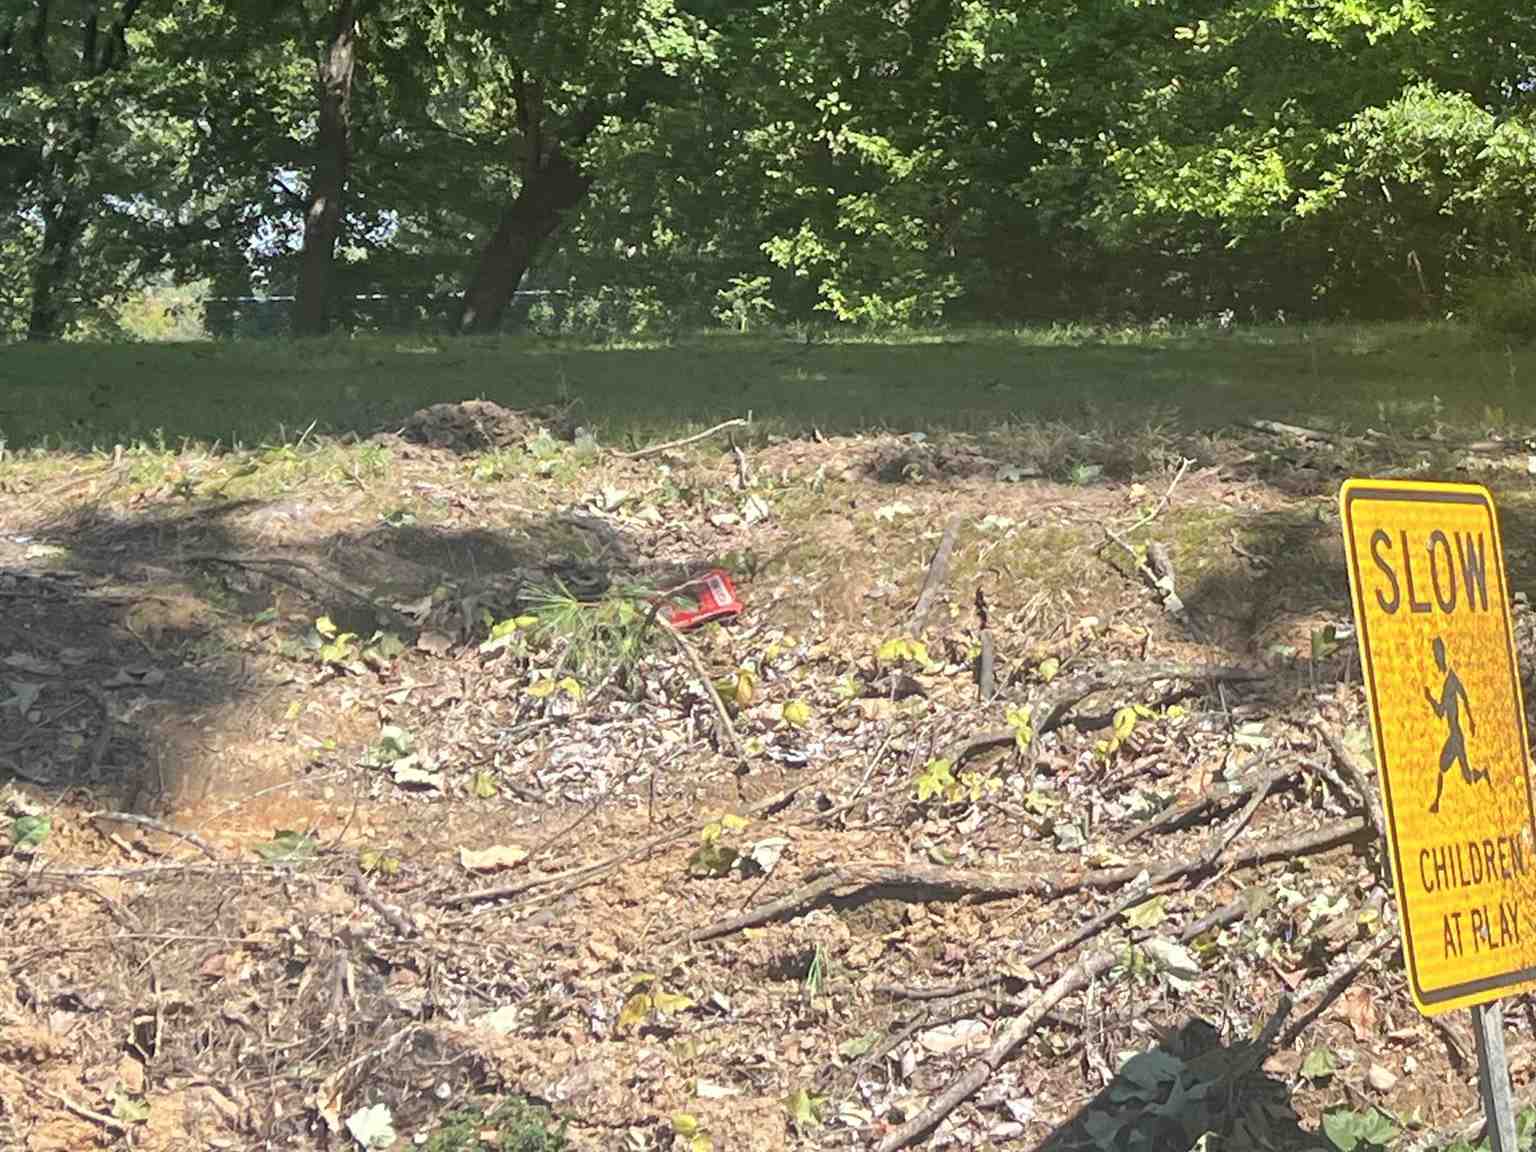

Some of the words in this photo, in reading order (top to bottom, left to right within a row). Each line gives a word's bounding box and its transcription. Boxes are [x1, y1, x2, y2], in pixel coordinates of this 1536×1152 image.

[1370, 528, 1489, 615] SLOW
[1419, 832, 1526, 893] CHILDREN
[1443, 911, 1463, 960] AT
[1470, 901, 1520, 953] PLAY
